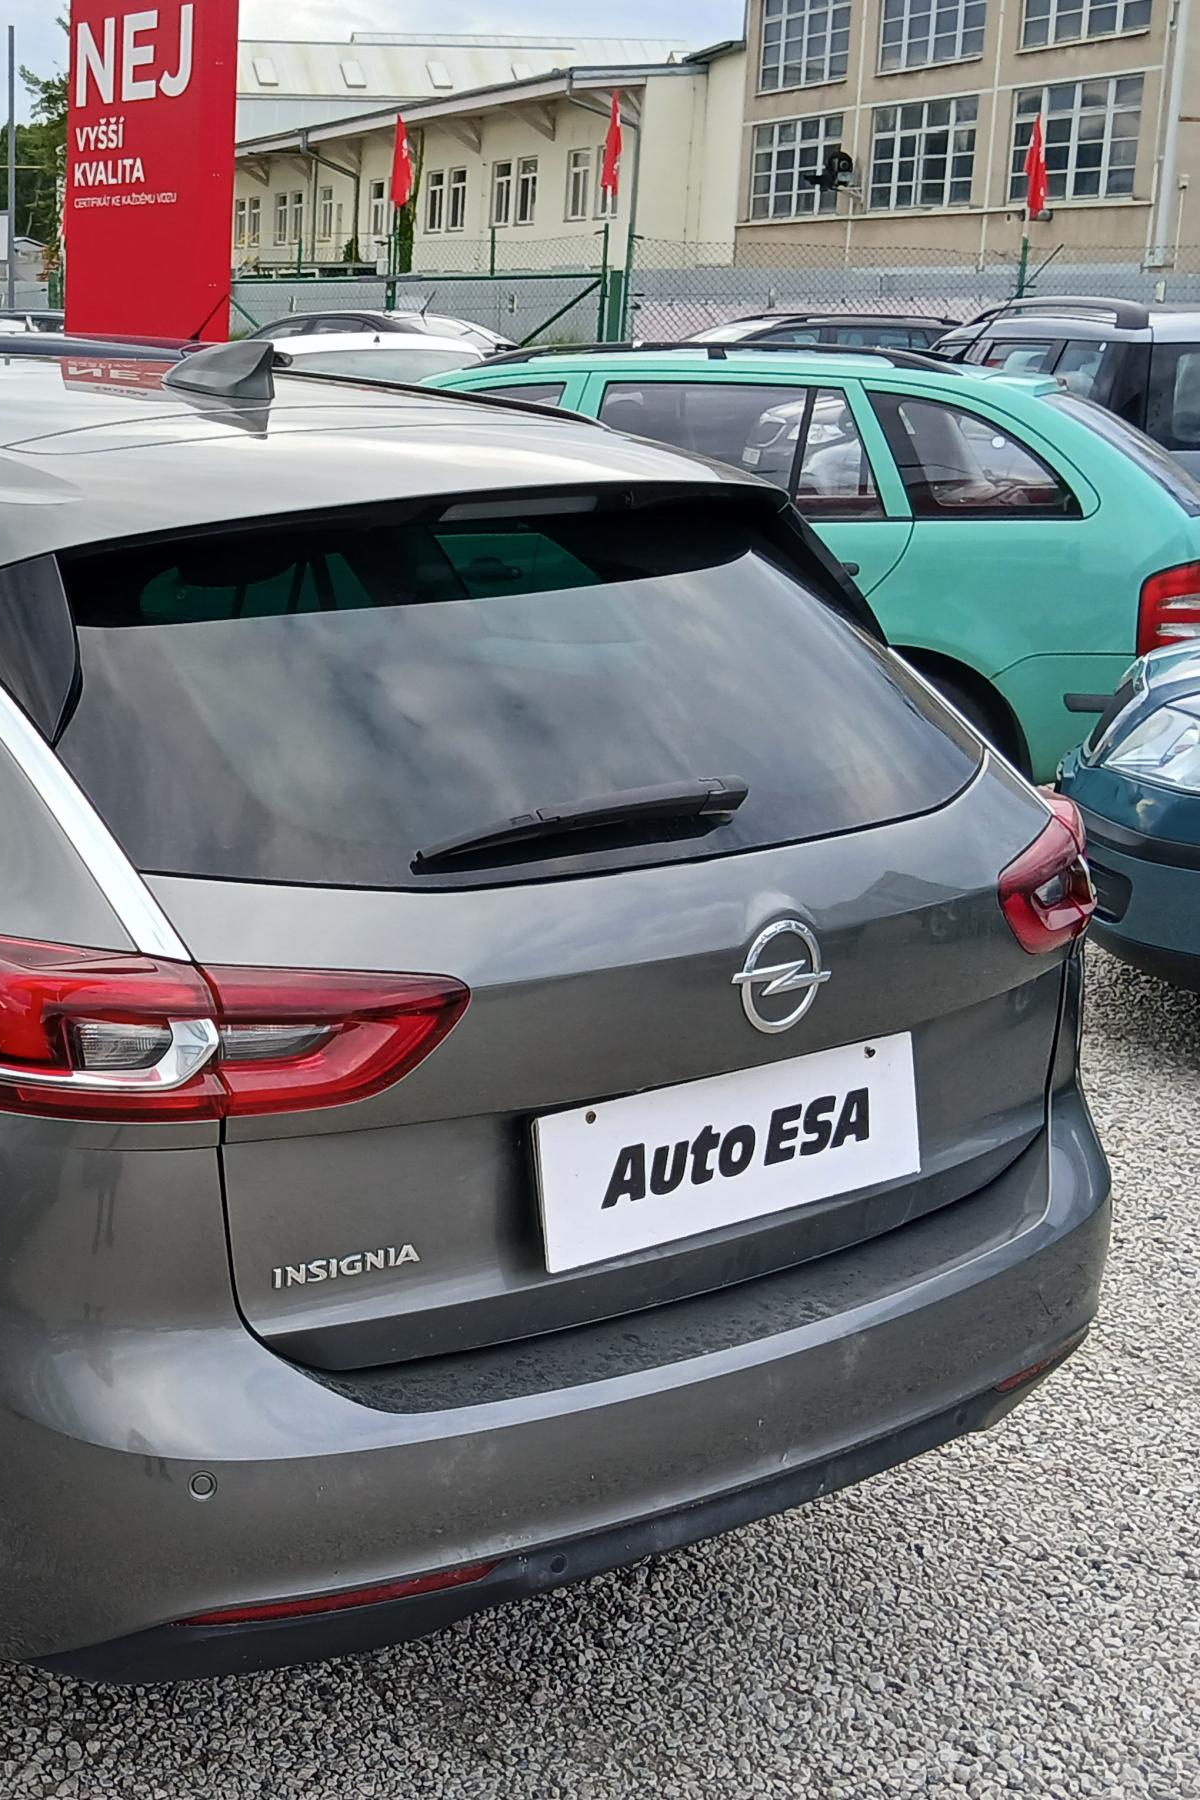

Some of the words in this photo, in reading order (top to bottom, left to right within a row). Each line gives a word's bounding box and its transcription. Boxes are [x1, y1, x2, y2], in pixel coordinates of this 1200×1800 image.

[75, 4, 194, 108] NEJ
[76, 116, 125, 152] VYŠŠÍ
[74, 158, 145, 187] KVALITA
[600, 1124, 756, 1210] Auto
[763, 1087, 870, 1167] ESA
[273, 1243, 421, 1290] INSIGNIA
